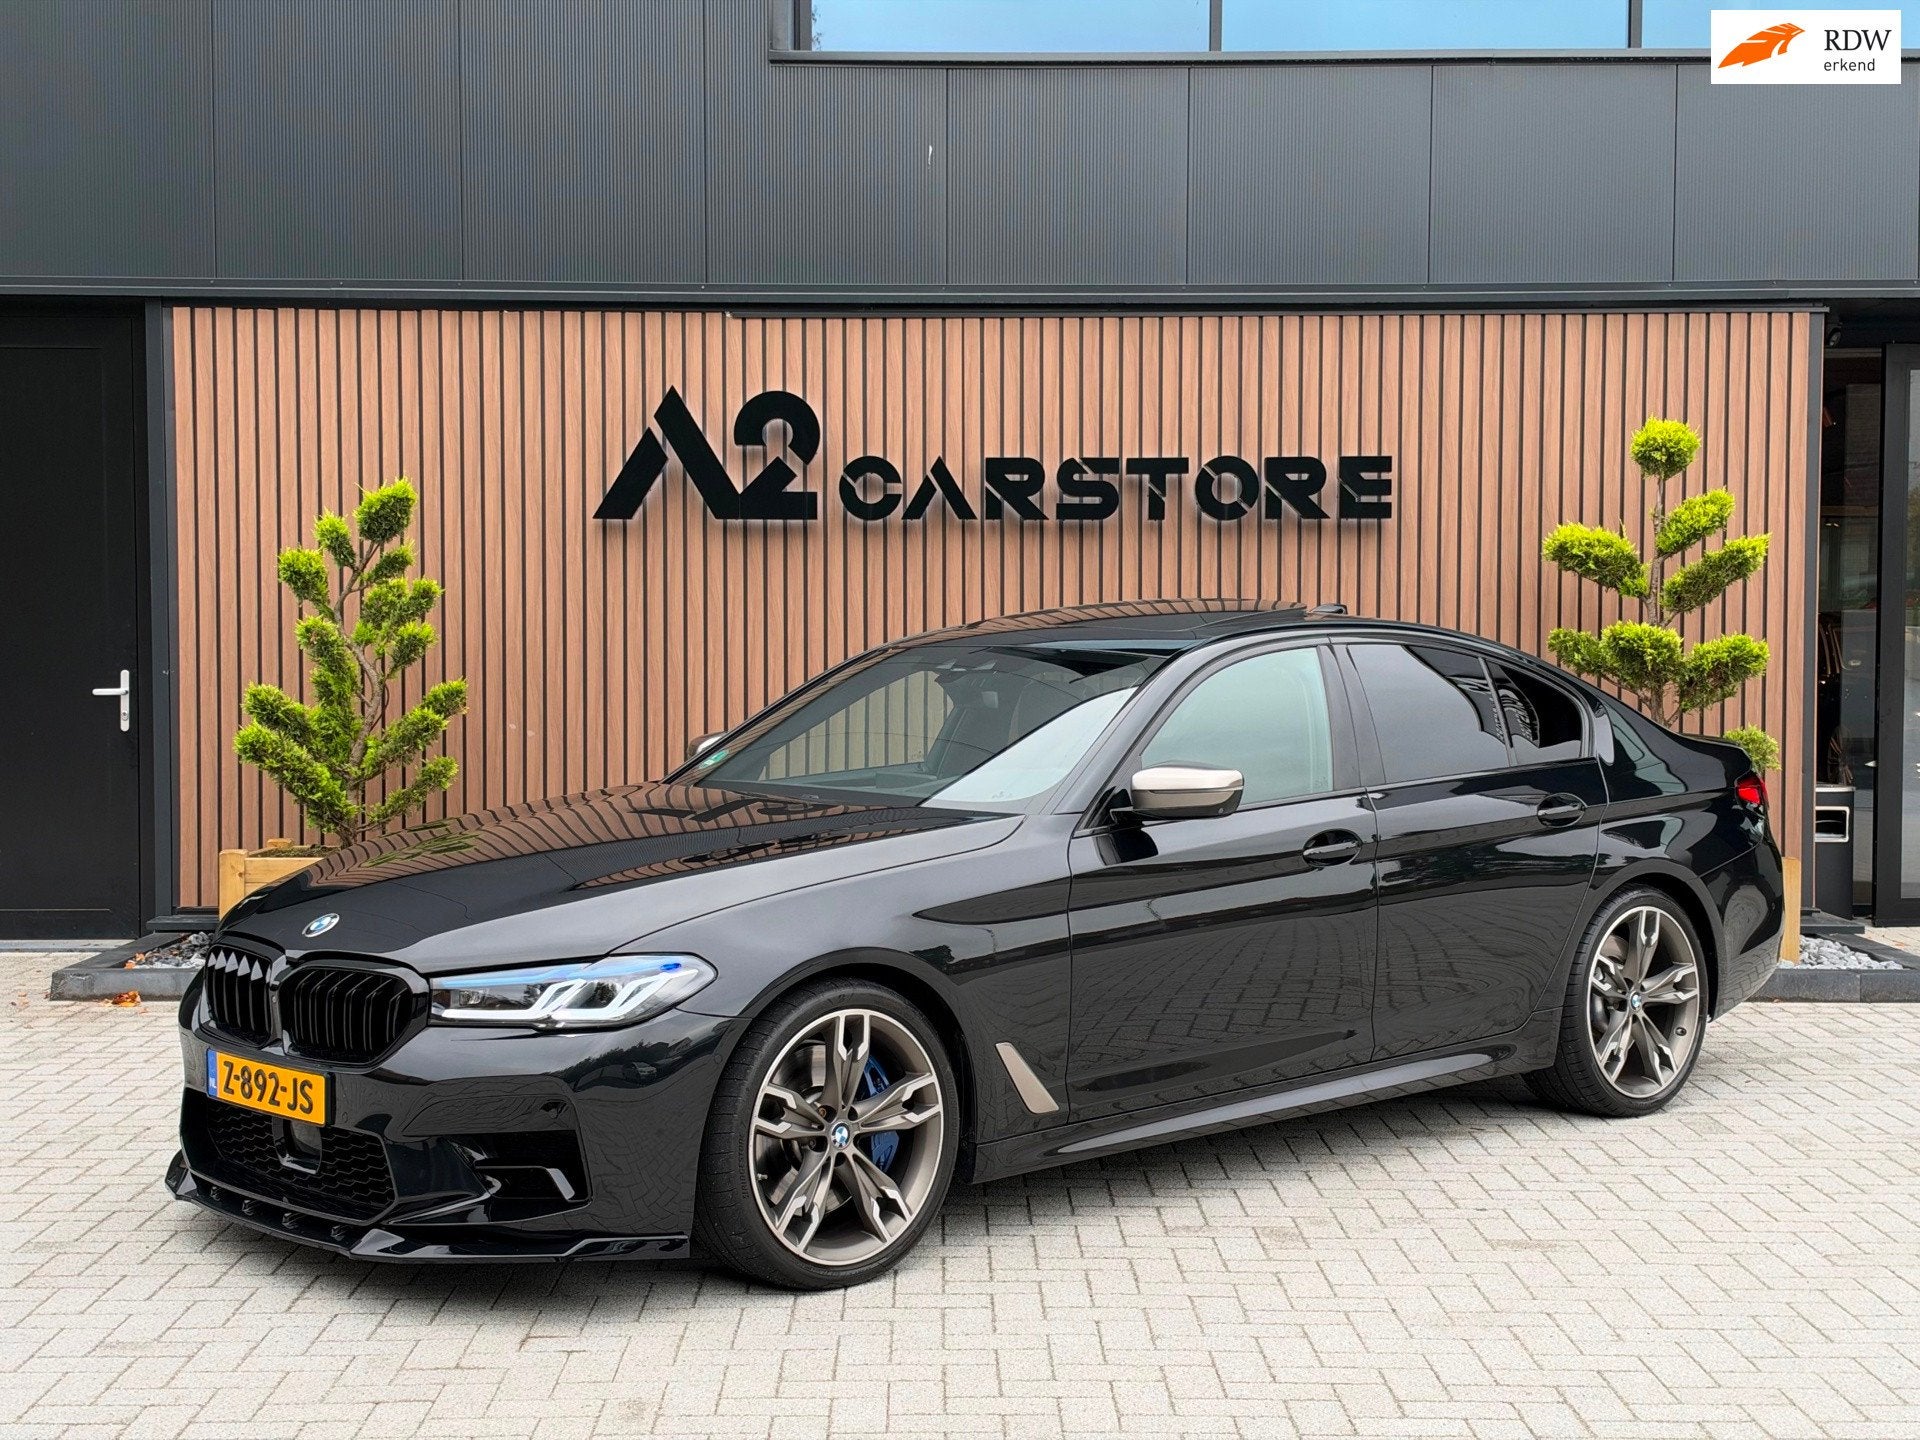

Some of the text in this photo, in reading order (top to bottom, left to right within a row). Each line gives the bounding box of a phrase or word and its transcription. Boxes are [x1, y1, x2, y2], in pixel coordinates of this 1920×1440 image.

[592, 384, 1393, 520] A2 CARSTORE
[223, 1060, 314, 1115] Z-892-JS
